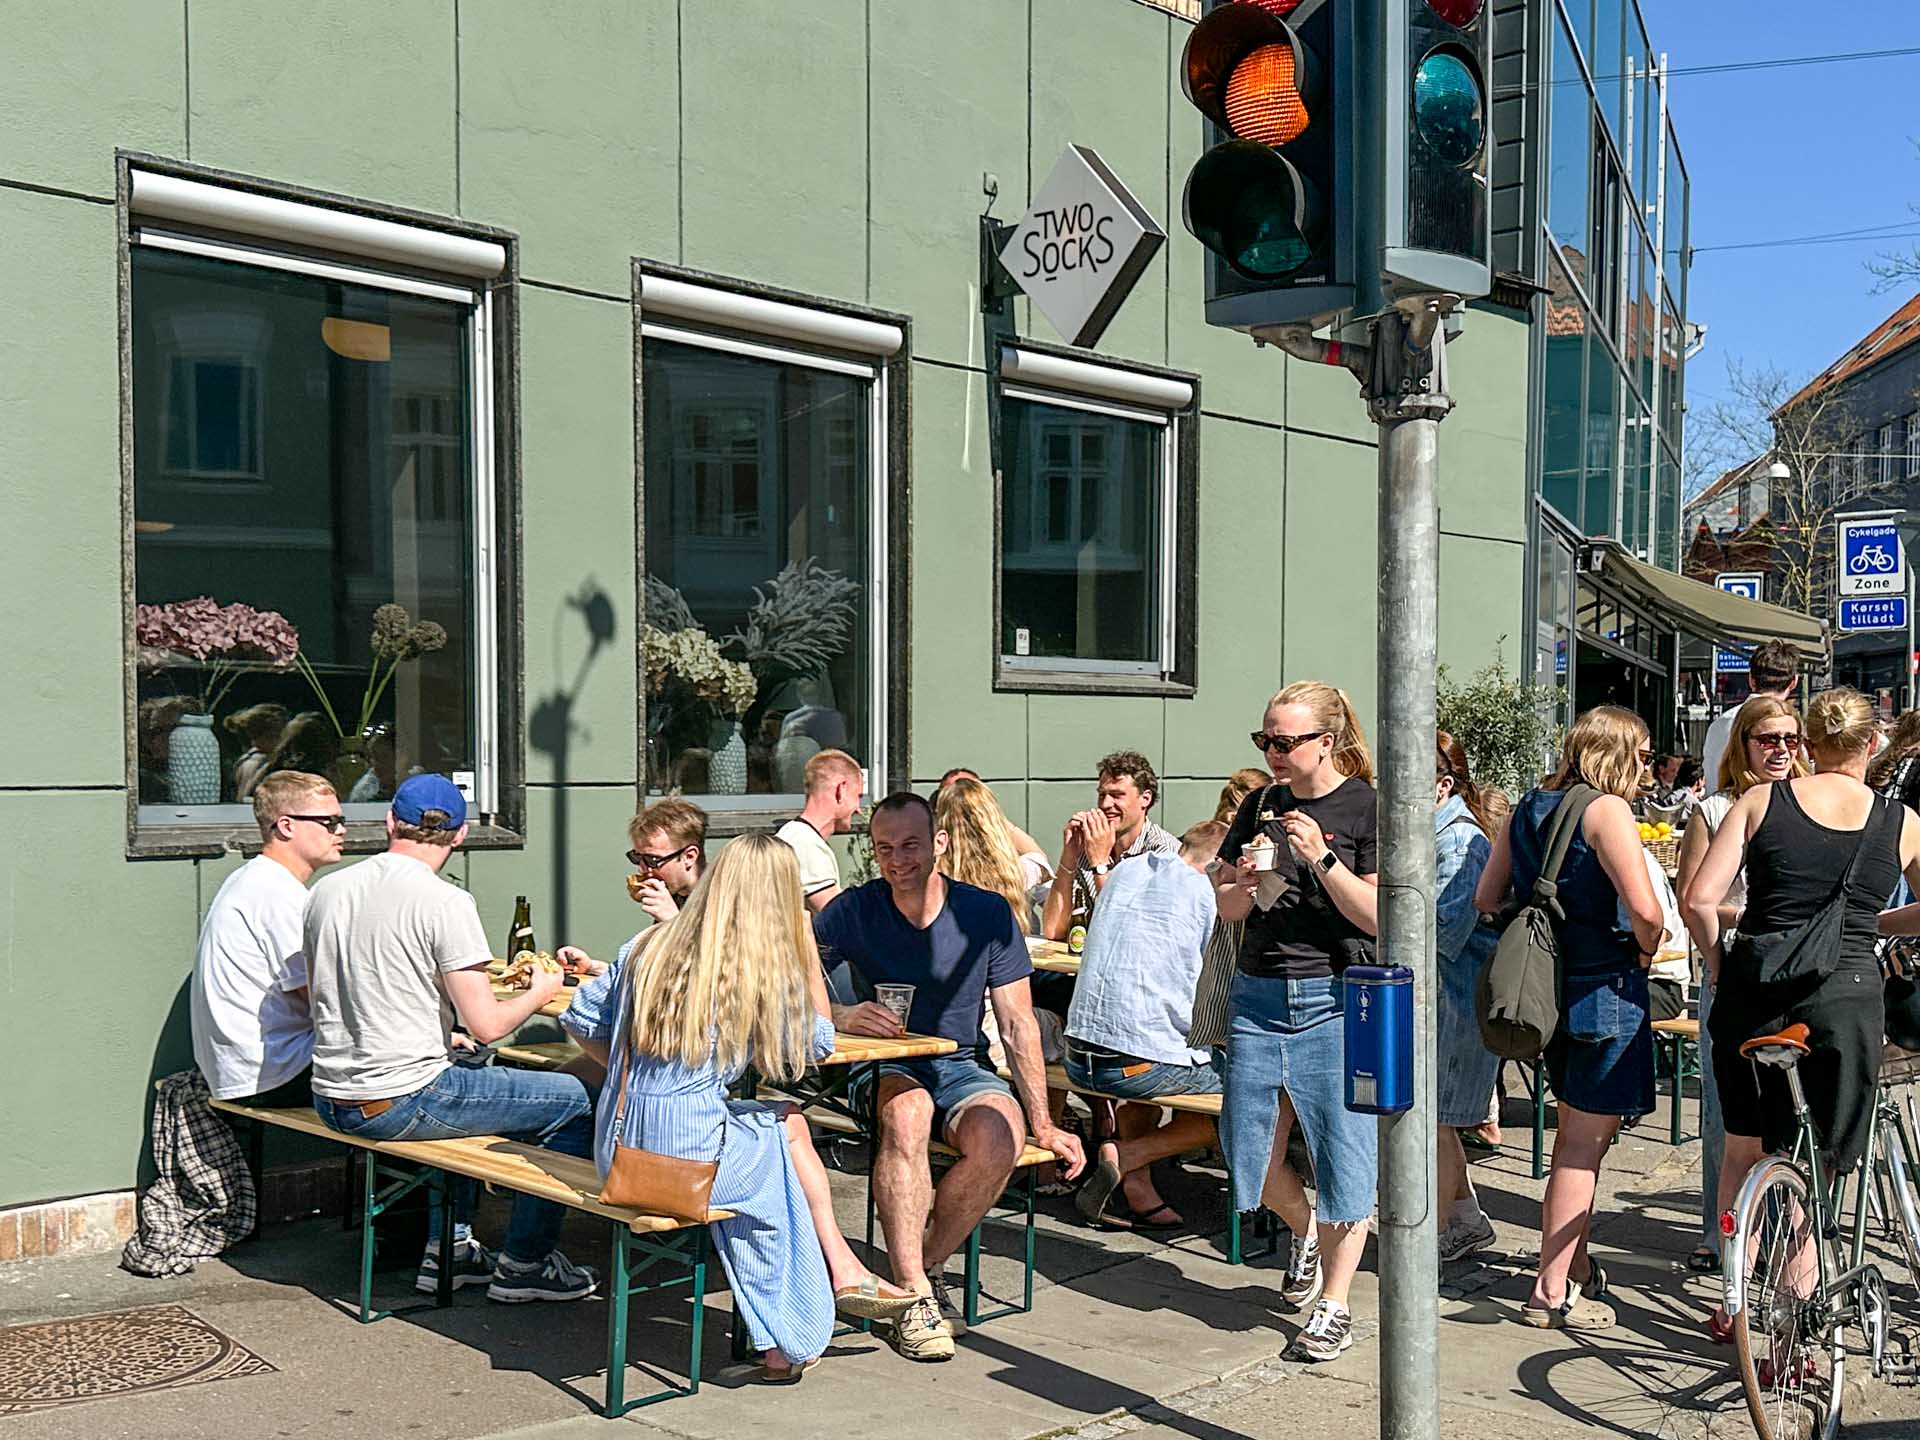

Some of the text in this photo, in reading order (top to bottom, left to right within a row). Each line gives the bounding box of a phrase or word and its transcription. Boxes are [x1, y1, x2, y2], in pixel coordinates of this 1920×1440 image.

[1033, 202, 1094, 240] TWO
[1023, 215, 1115, 282] SOCKS
[1848, 527, 1896, 539] Cykelgade
[1854, 578, 1890, 590] Zone
[1851, 602, 1895, 613] Kørsel
[1851, 614, 1895, 625] tilladt
